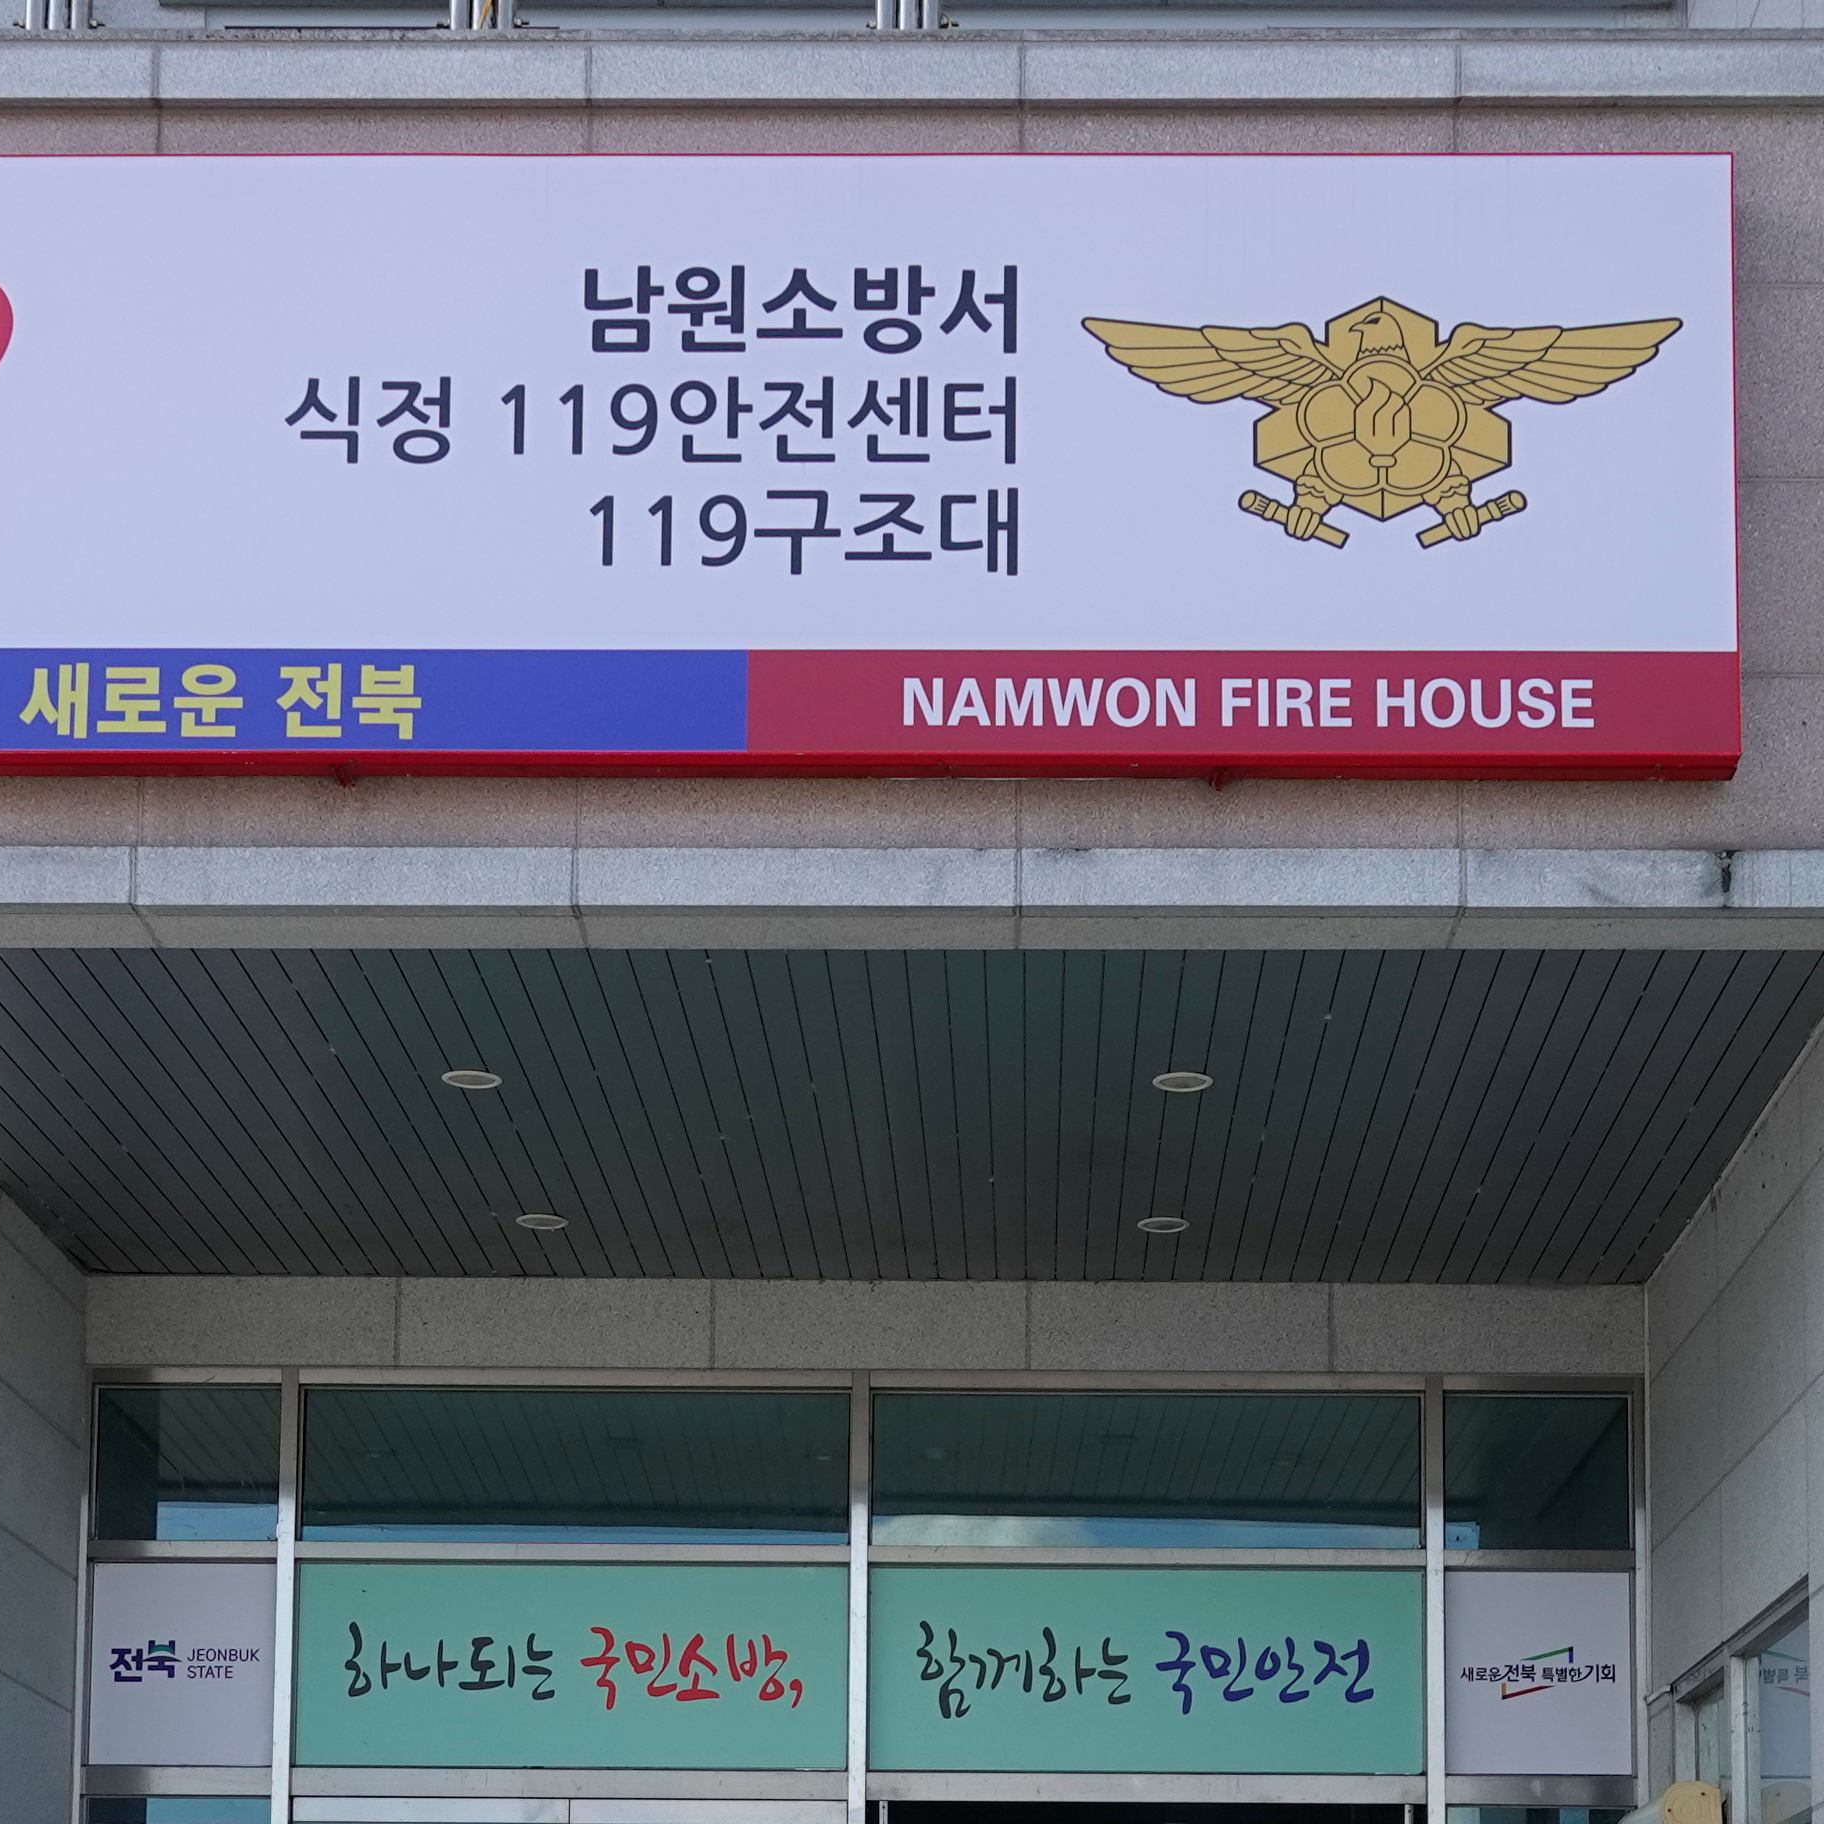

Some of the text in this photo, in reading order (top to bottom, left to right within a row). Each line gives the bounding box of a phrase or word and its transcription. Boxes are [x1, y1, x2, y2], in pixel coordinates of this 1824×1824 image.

[584, 265, 1018, 354] 남원소방서
[285, 376, 1018, 465] 식정 119안전센터
[590, 488, 1019, 576] 119구조대
[20, 663, 244, 741] 새로운
[277, 664, 424, 741] 전북
[904, 678, 1595, 728] NAMWON FIRE HOUSE
[109, 1640, 182, 1682] 전북
[187, 1648, 260, 1662] JEONBUK
[187, 1666, 234, 1679] STATE
[345, 1621, 805, 1711] 하나되는 국민소방,
[917, 1620, 1375, 1719] 함께하는 국민안전
